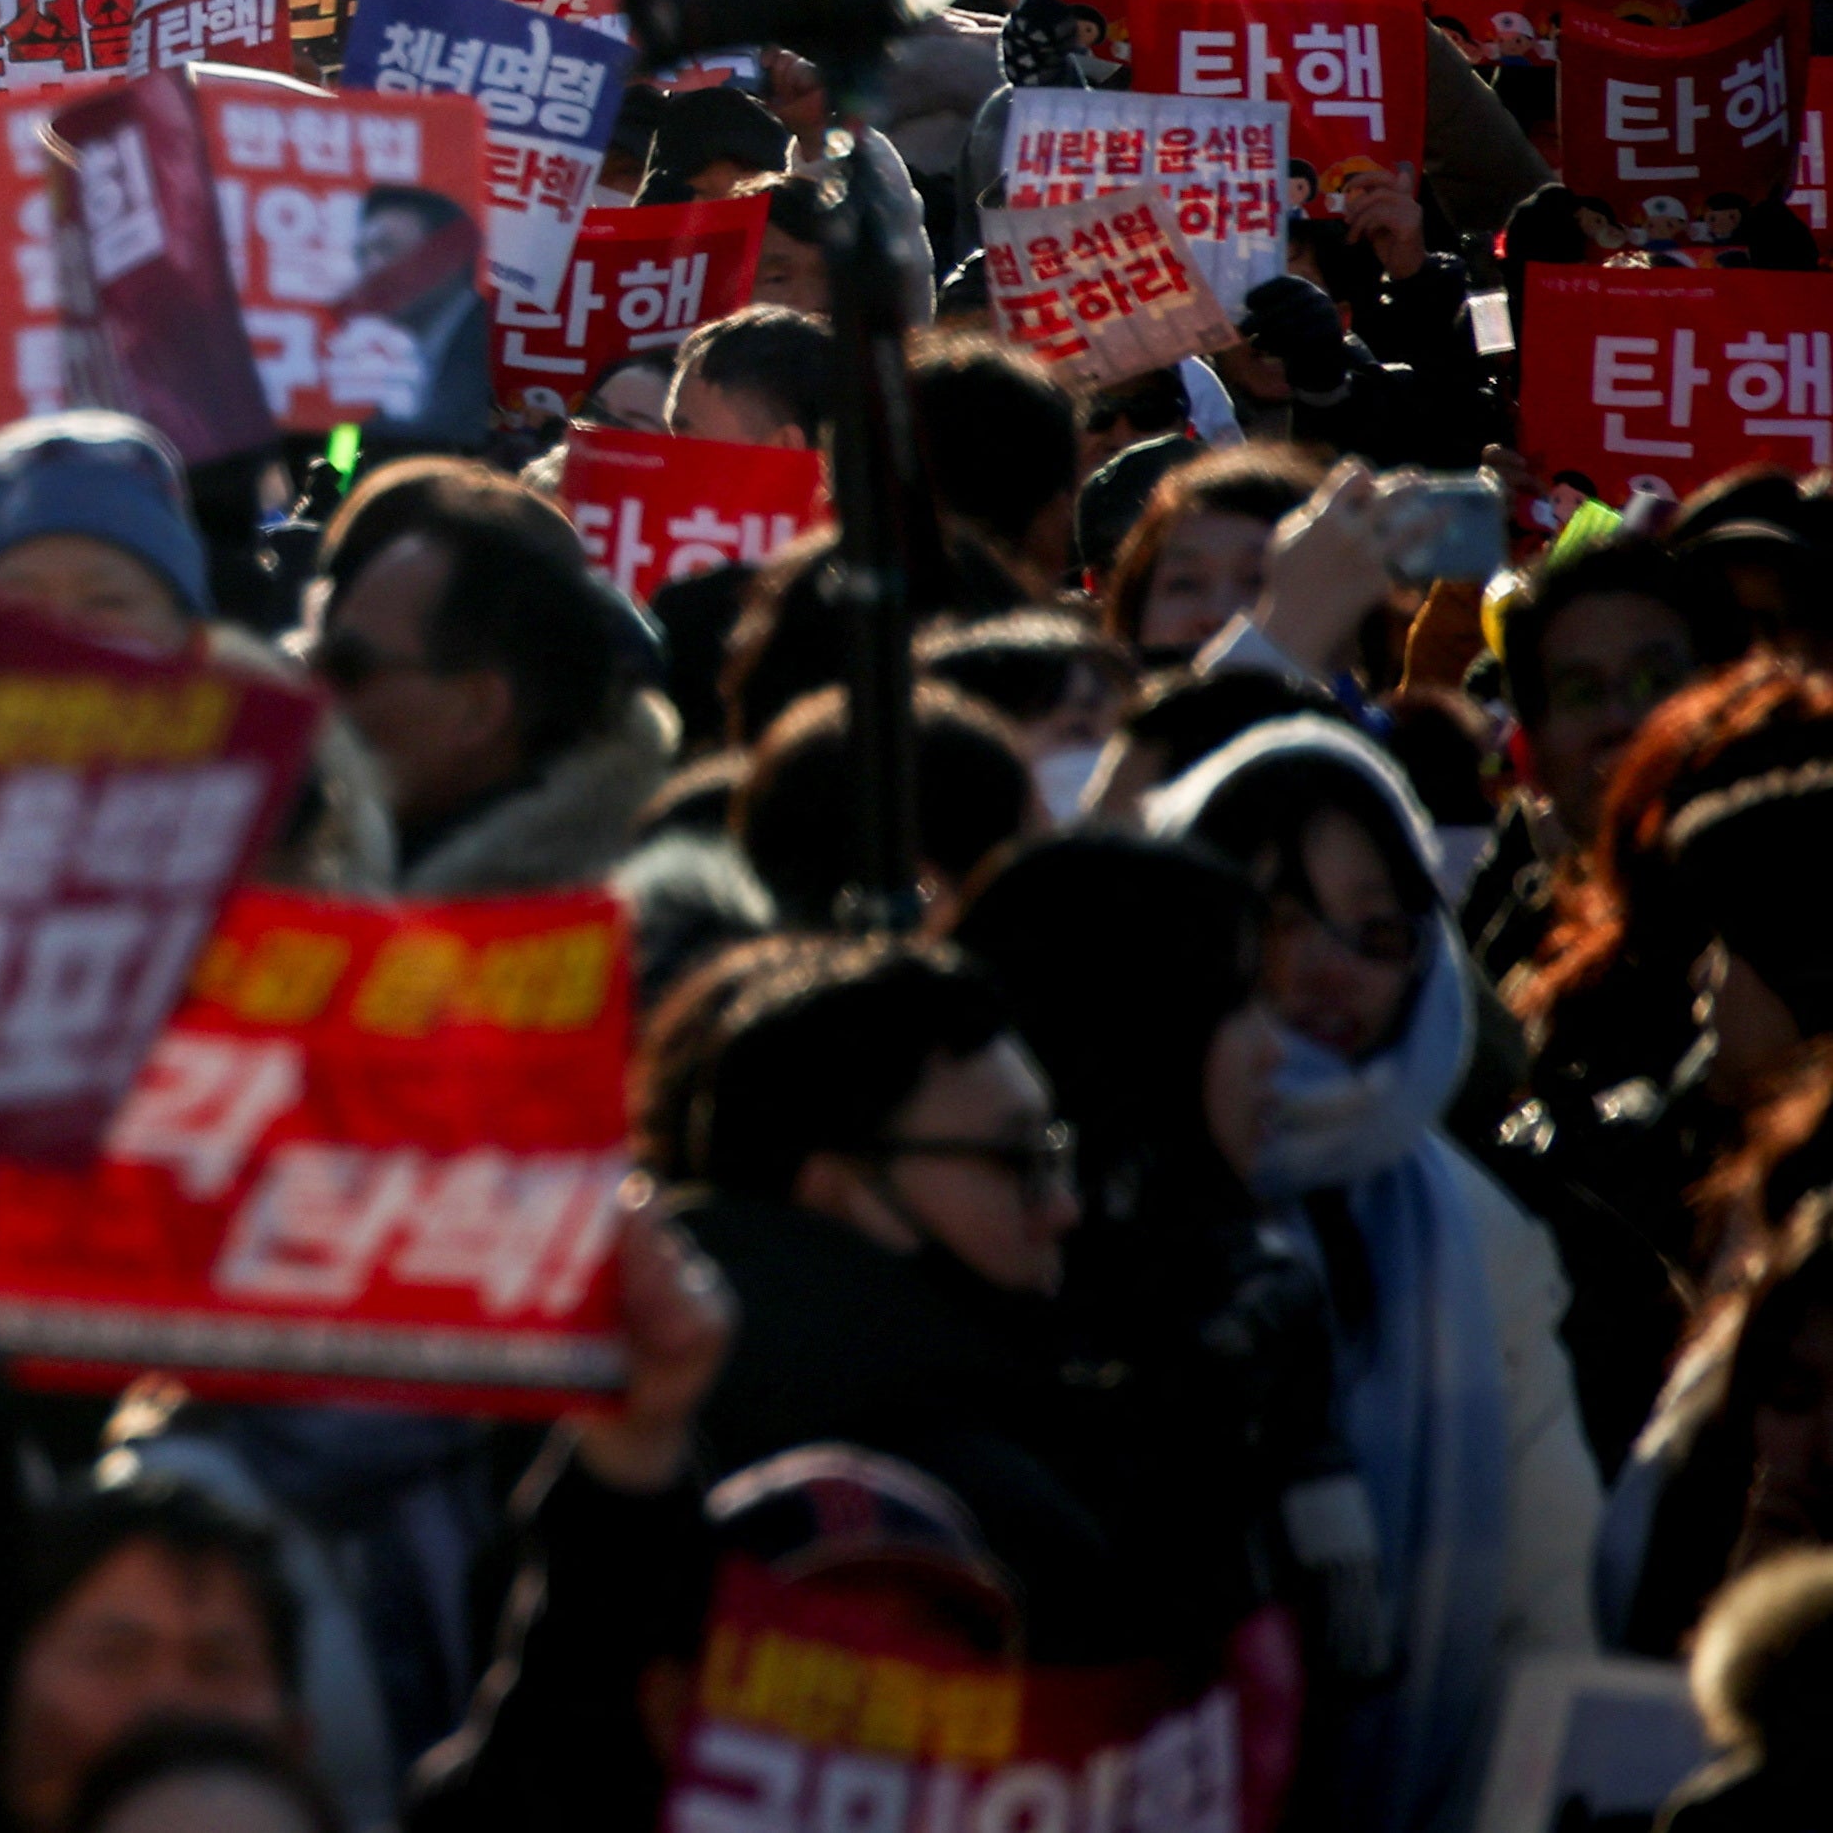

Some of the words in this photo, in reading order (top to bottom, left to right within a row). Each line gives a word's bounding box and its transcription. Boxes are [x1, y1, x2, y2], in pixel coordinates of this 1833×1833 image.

[1178, 21, 1387, 144] 탄핵
[1605, 37, 1791, 182] 탄핵
[1017, 127, 1146, 177] 내란범
[1155, 120, 1277, 170] 윤석열
[1026, 207, 1161, 285] 윤석열
[1591, 327, 1833, 467] 탄핵
